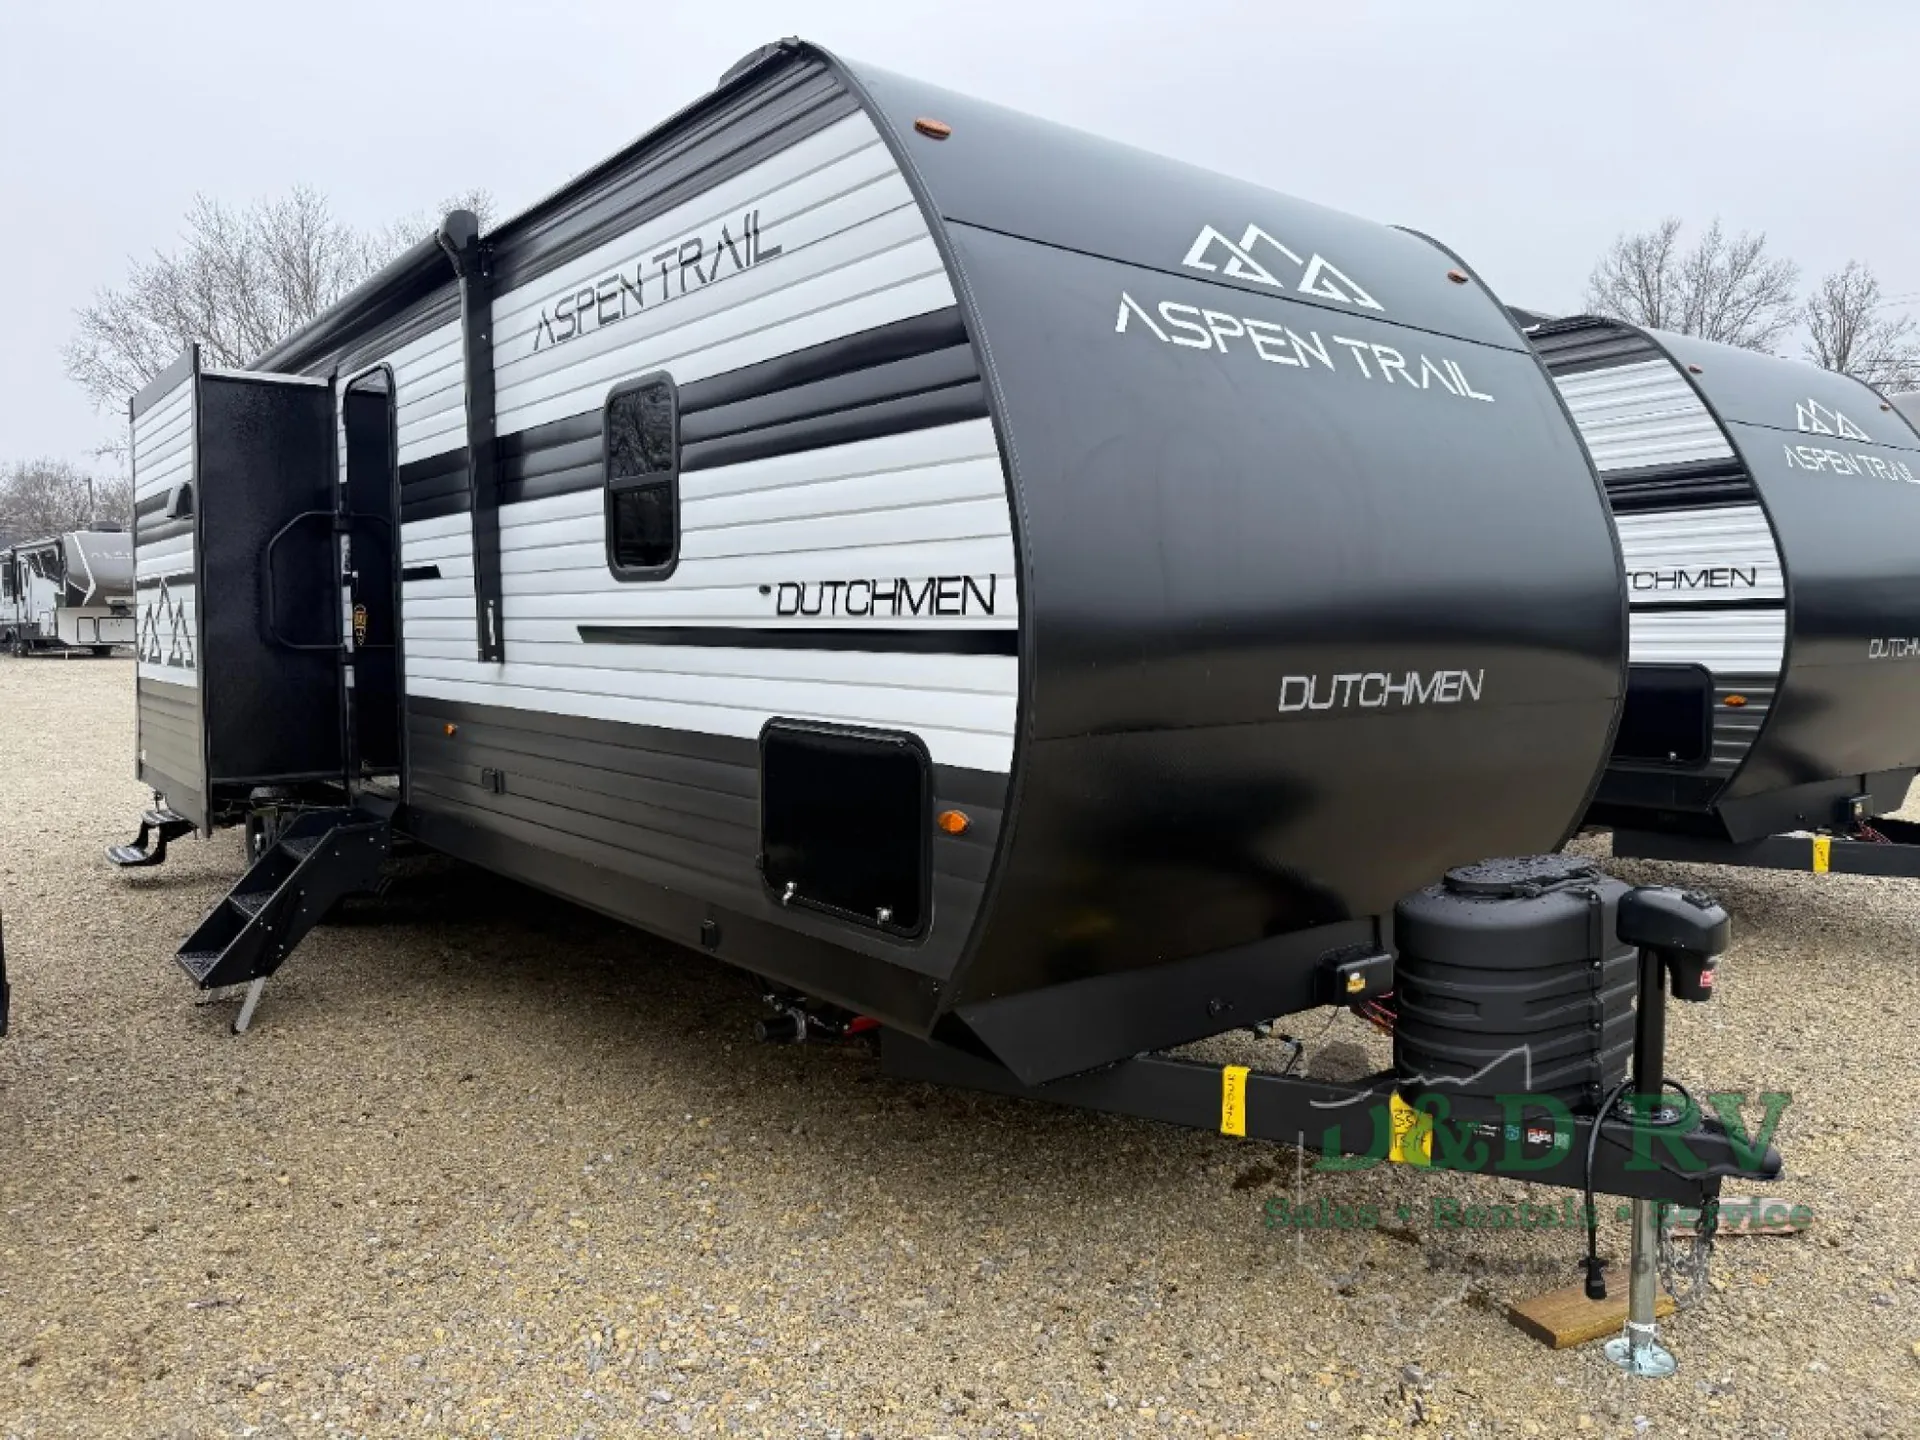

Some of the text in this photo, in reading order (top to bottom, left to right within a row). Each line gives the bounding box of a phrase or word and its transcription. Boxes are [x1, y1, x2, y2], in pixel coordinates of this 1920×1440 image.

[533, 209, 783, 352] ASPEN TRAIL
[1115, 291, 1495, 402] ASPEN TRAIL
[1782, 444, 1864, 476] ASPEN
[777, 574, 996, 616] DUTCHMEN
[1626, 567, 1755, 590] CHMEN
[1278, 669, 1485, 712] DUTCHMEN
